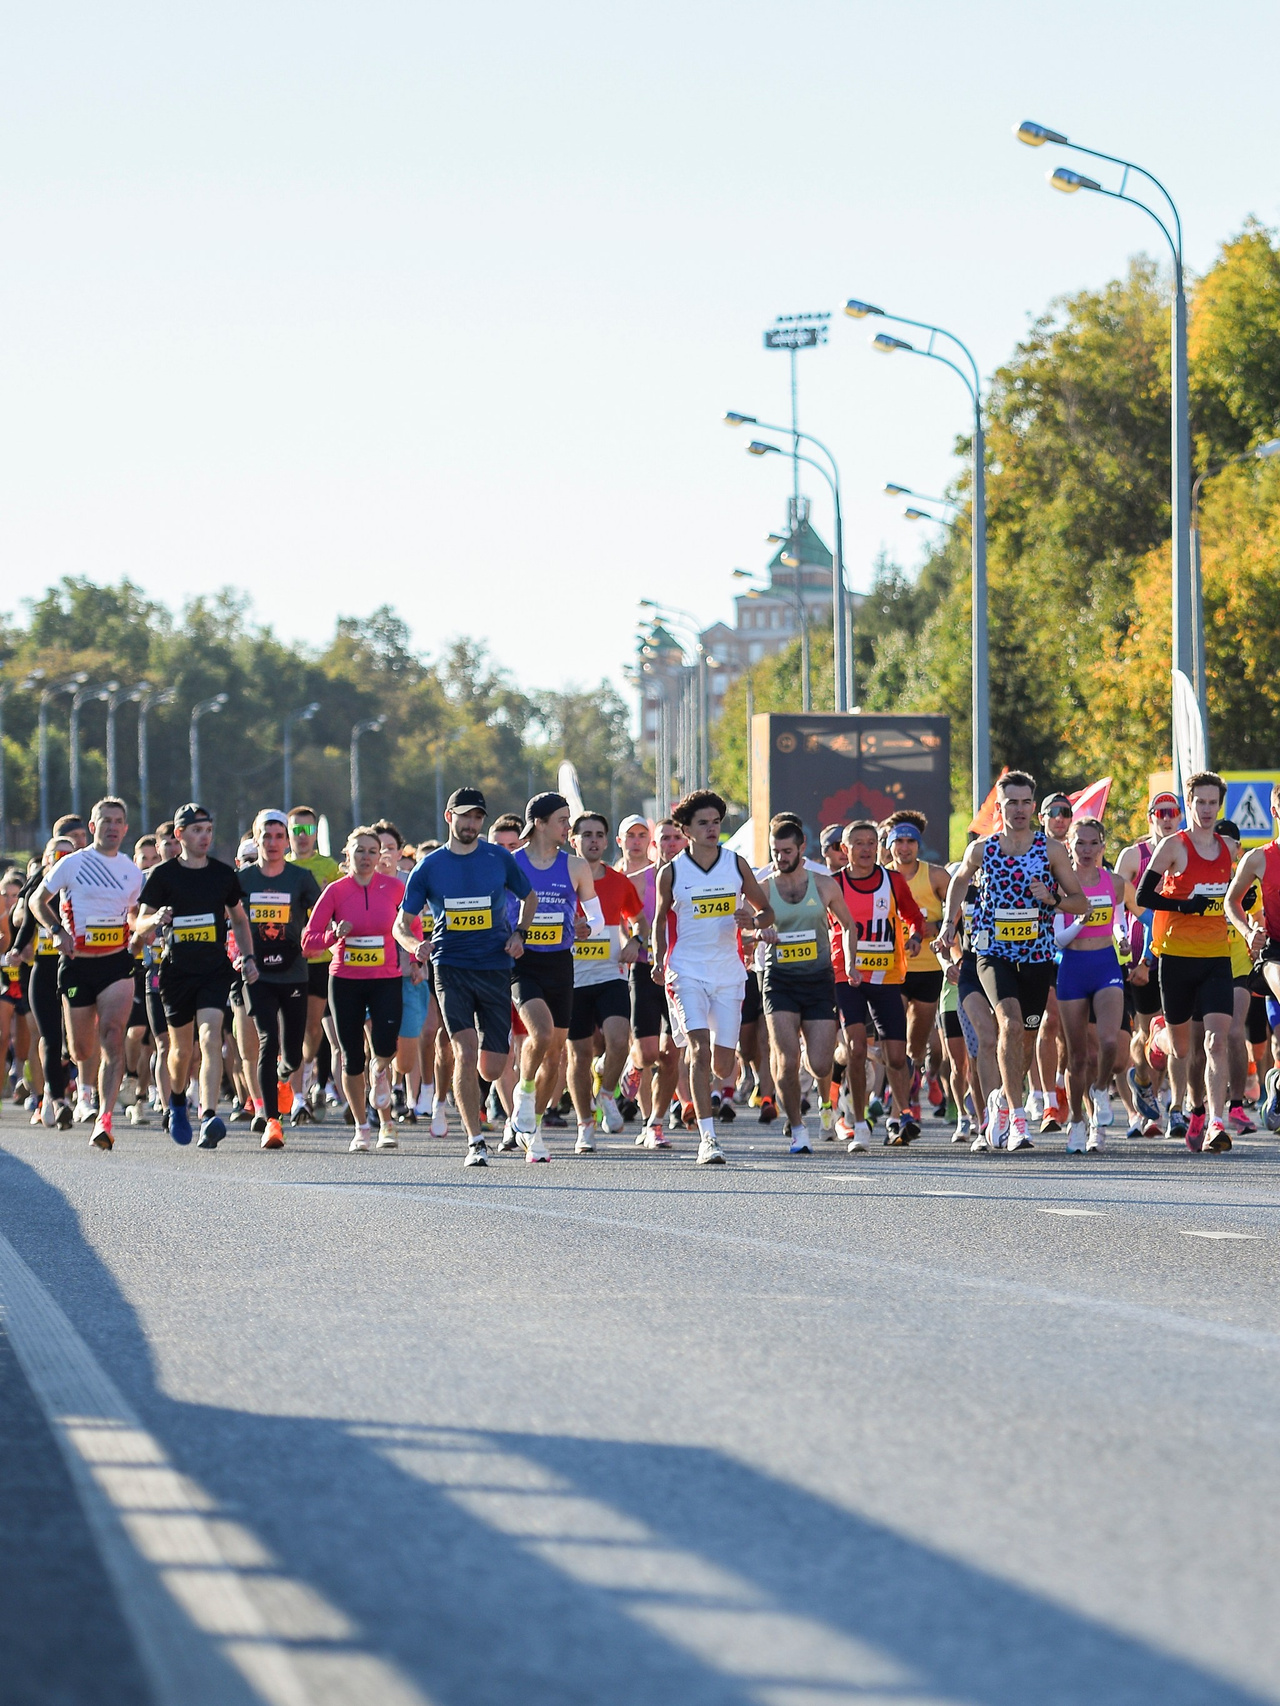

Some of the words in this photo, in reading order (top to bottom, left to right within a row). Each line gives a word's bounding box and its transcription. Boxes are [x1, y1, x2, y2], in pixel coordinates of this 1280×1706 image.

[700, 902, 730, 914] 3748
[1207, 902, 1223, 911] 900
[256, 909, 282, 919] 3881
[1089, 912, 1108, 922] 675
[452, 915, 485, 926] 4788
[1001, 926, 1032, 936] 4128
[93, 932, 119, 942] 5010
[181, 931, 209, 942] 3873
[576, 946, 604, 955] 4974
[783, 947, 811, 958] 3130
[350, 953, 378, 962] 5636
[862, 957, 889, 967] 4683
